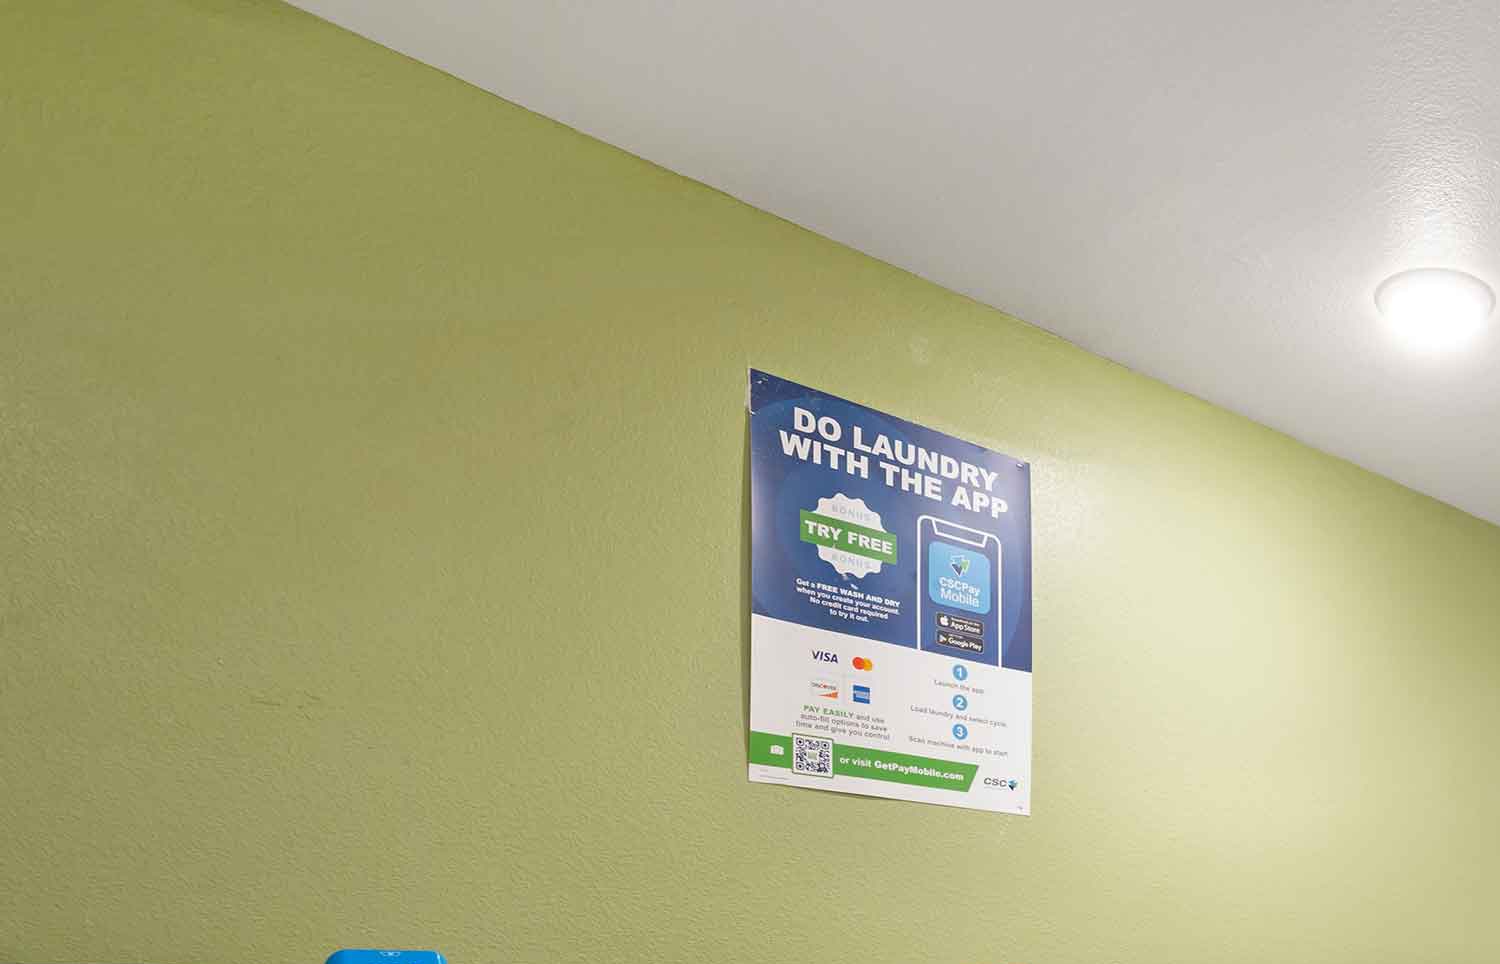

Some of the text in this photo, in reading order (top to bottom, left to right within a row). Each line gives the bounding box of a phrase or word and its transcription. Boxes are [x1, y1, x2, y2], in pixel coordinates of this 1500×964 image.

[793, 406, 1000, 492] DO LAUNDRY
[779, 429, 1009, 519] WITH THE APP
[804, 520, 893, 554] TRY FREE
[796, 578, 809, 587] Get
[816, 583, 839, 593] FREE
[840, 588, 865, 600] WASH
[866, 594, 883, 604] AND
[884, 599, 900, 608] DRY
[939, 577, 980, 597] CSCPay
[796, 587, 816, 597] when
[817, 591, 831, 600] you
[831, 594, 854, 604] create
[940, 587, 979, 608] Mobile
[810, 596, 889, 620] No credit card required
[838, 611, 848, 619] try
[951, 621, 964, 631] App
[964, 623, 981, 633] Store
[948, 637, 969, 648] Google
[811, 650, 839, 664] VISA
[956, 695, 964, 710] 2
[803, 704, 820, 713] PAY
[823, 708, 853, 718] EASILY
[814, 723, 829, 731] and
[831, 719, 860, 728] options
[861, 722, 869, 730] to
[955, 725, 963, 737] 3
[840, 756, 965, 782] or visit GetPayMobile.com
[983, 777, 1007, 788] CSC
